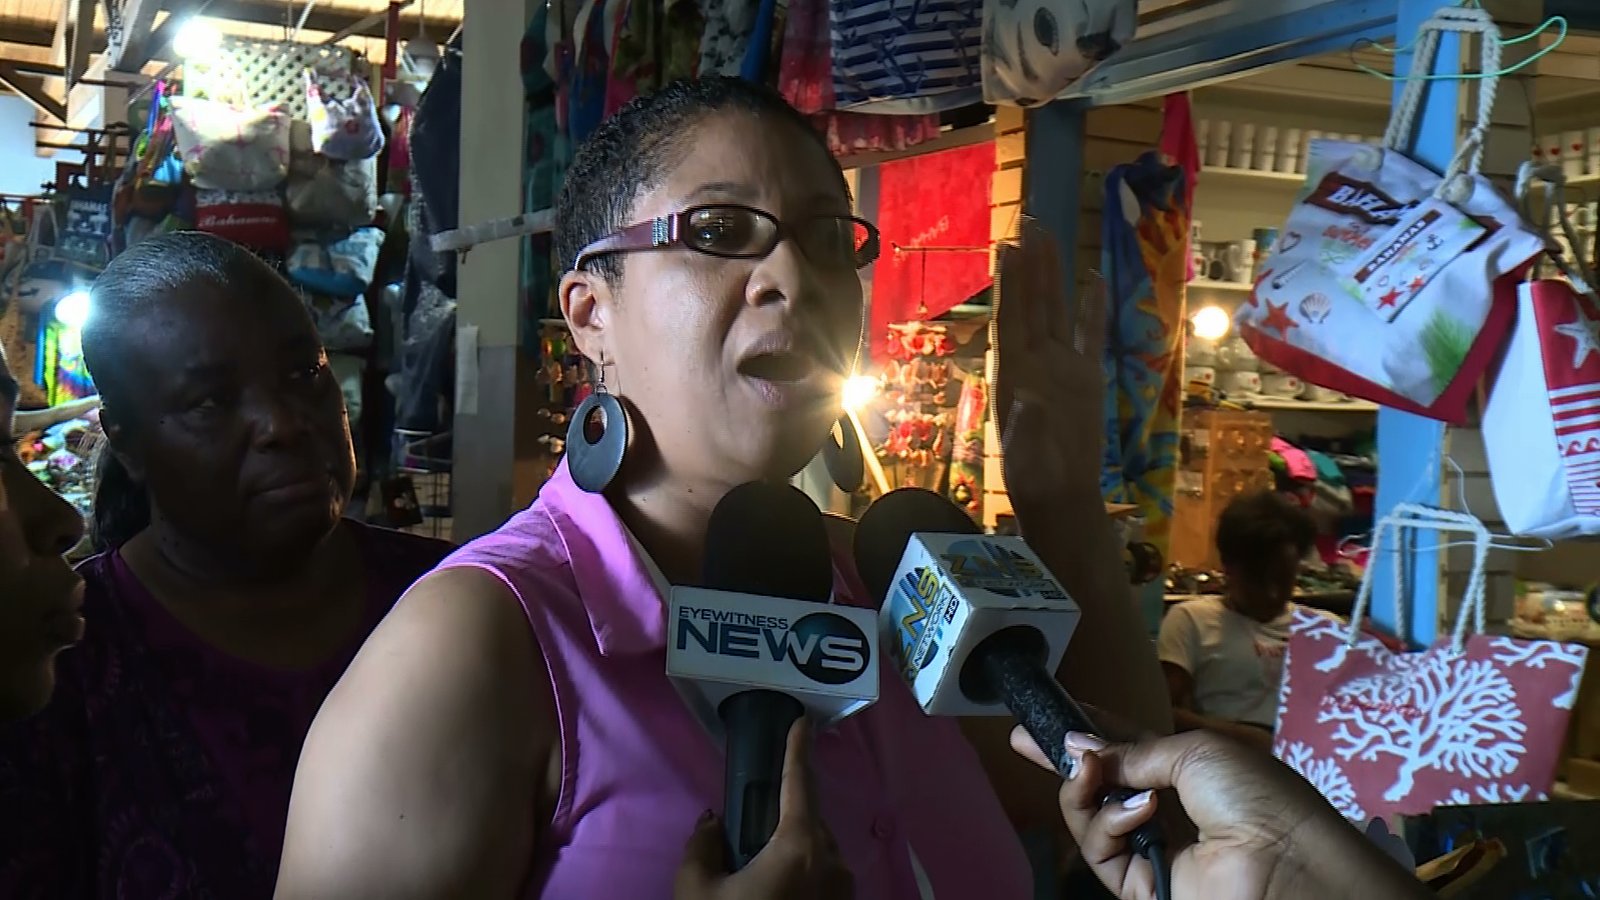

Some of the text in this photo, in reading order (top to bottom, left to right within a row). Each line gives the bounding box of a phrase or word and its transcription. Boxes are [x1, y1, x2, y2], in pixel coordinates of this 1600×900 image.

[677, 618, 864, 672] NEWS
[679, 606, 788, 630] EYEWITNESS
[913, 591, 949, 668] NETWORK
